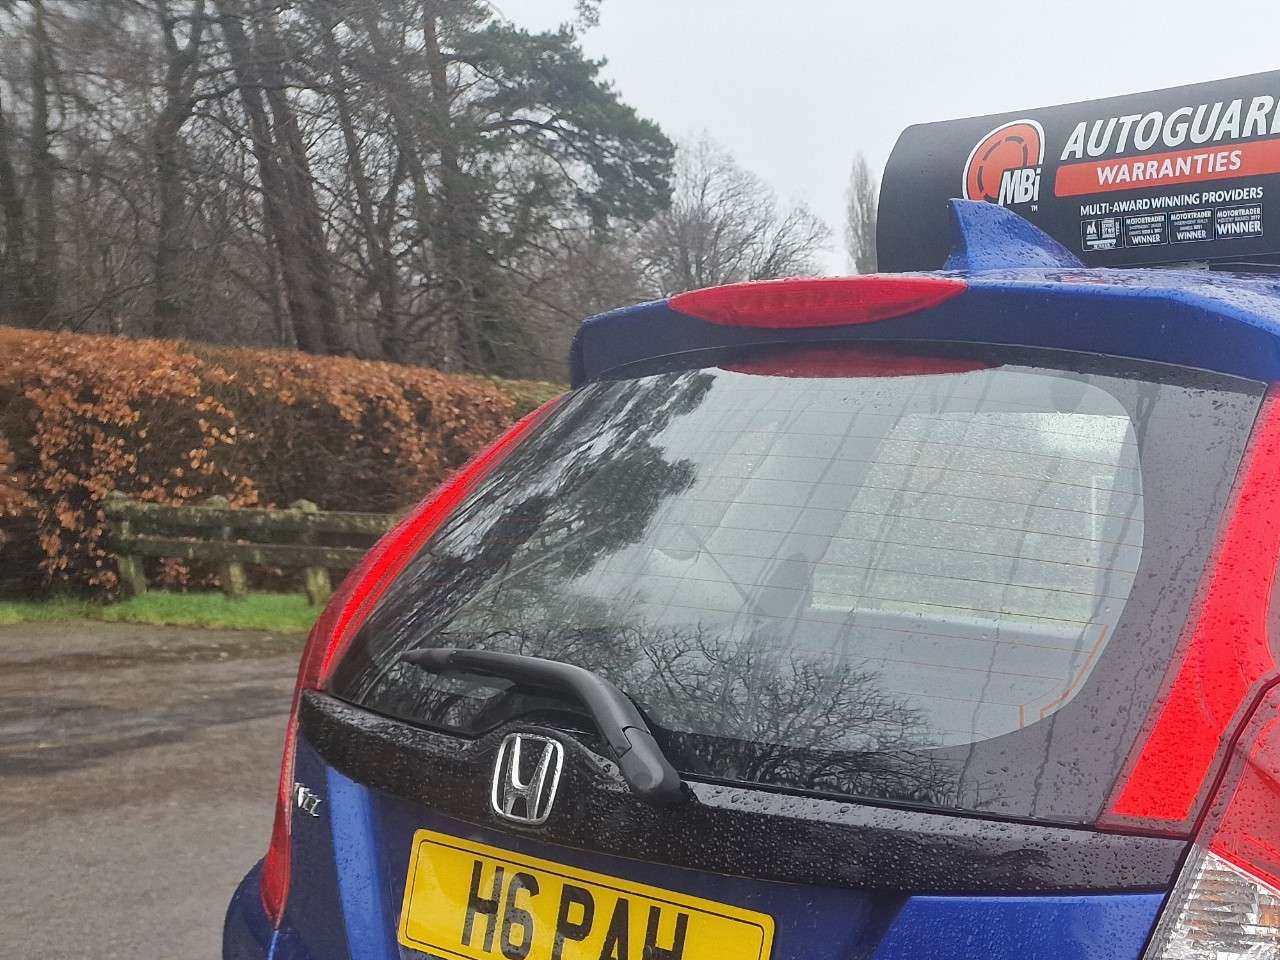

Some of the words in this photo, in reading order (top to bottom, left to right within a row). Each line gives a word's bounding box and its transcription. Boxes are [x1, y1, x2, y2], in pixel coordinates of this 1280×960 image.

[1096, 150, 1242, 185] WARRANTIES
[1080, 198, 1150, 216] MULTI-AWARD
[1151, 193, 1200, 209] WINNING
[1202, 187, 1264, 204] PROVIDERS
[1176, 229, 1207, 240] WINNER
[1216, 220, 1261, 235] WINNER
[1131, 233, 1161, 245] WINNER
